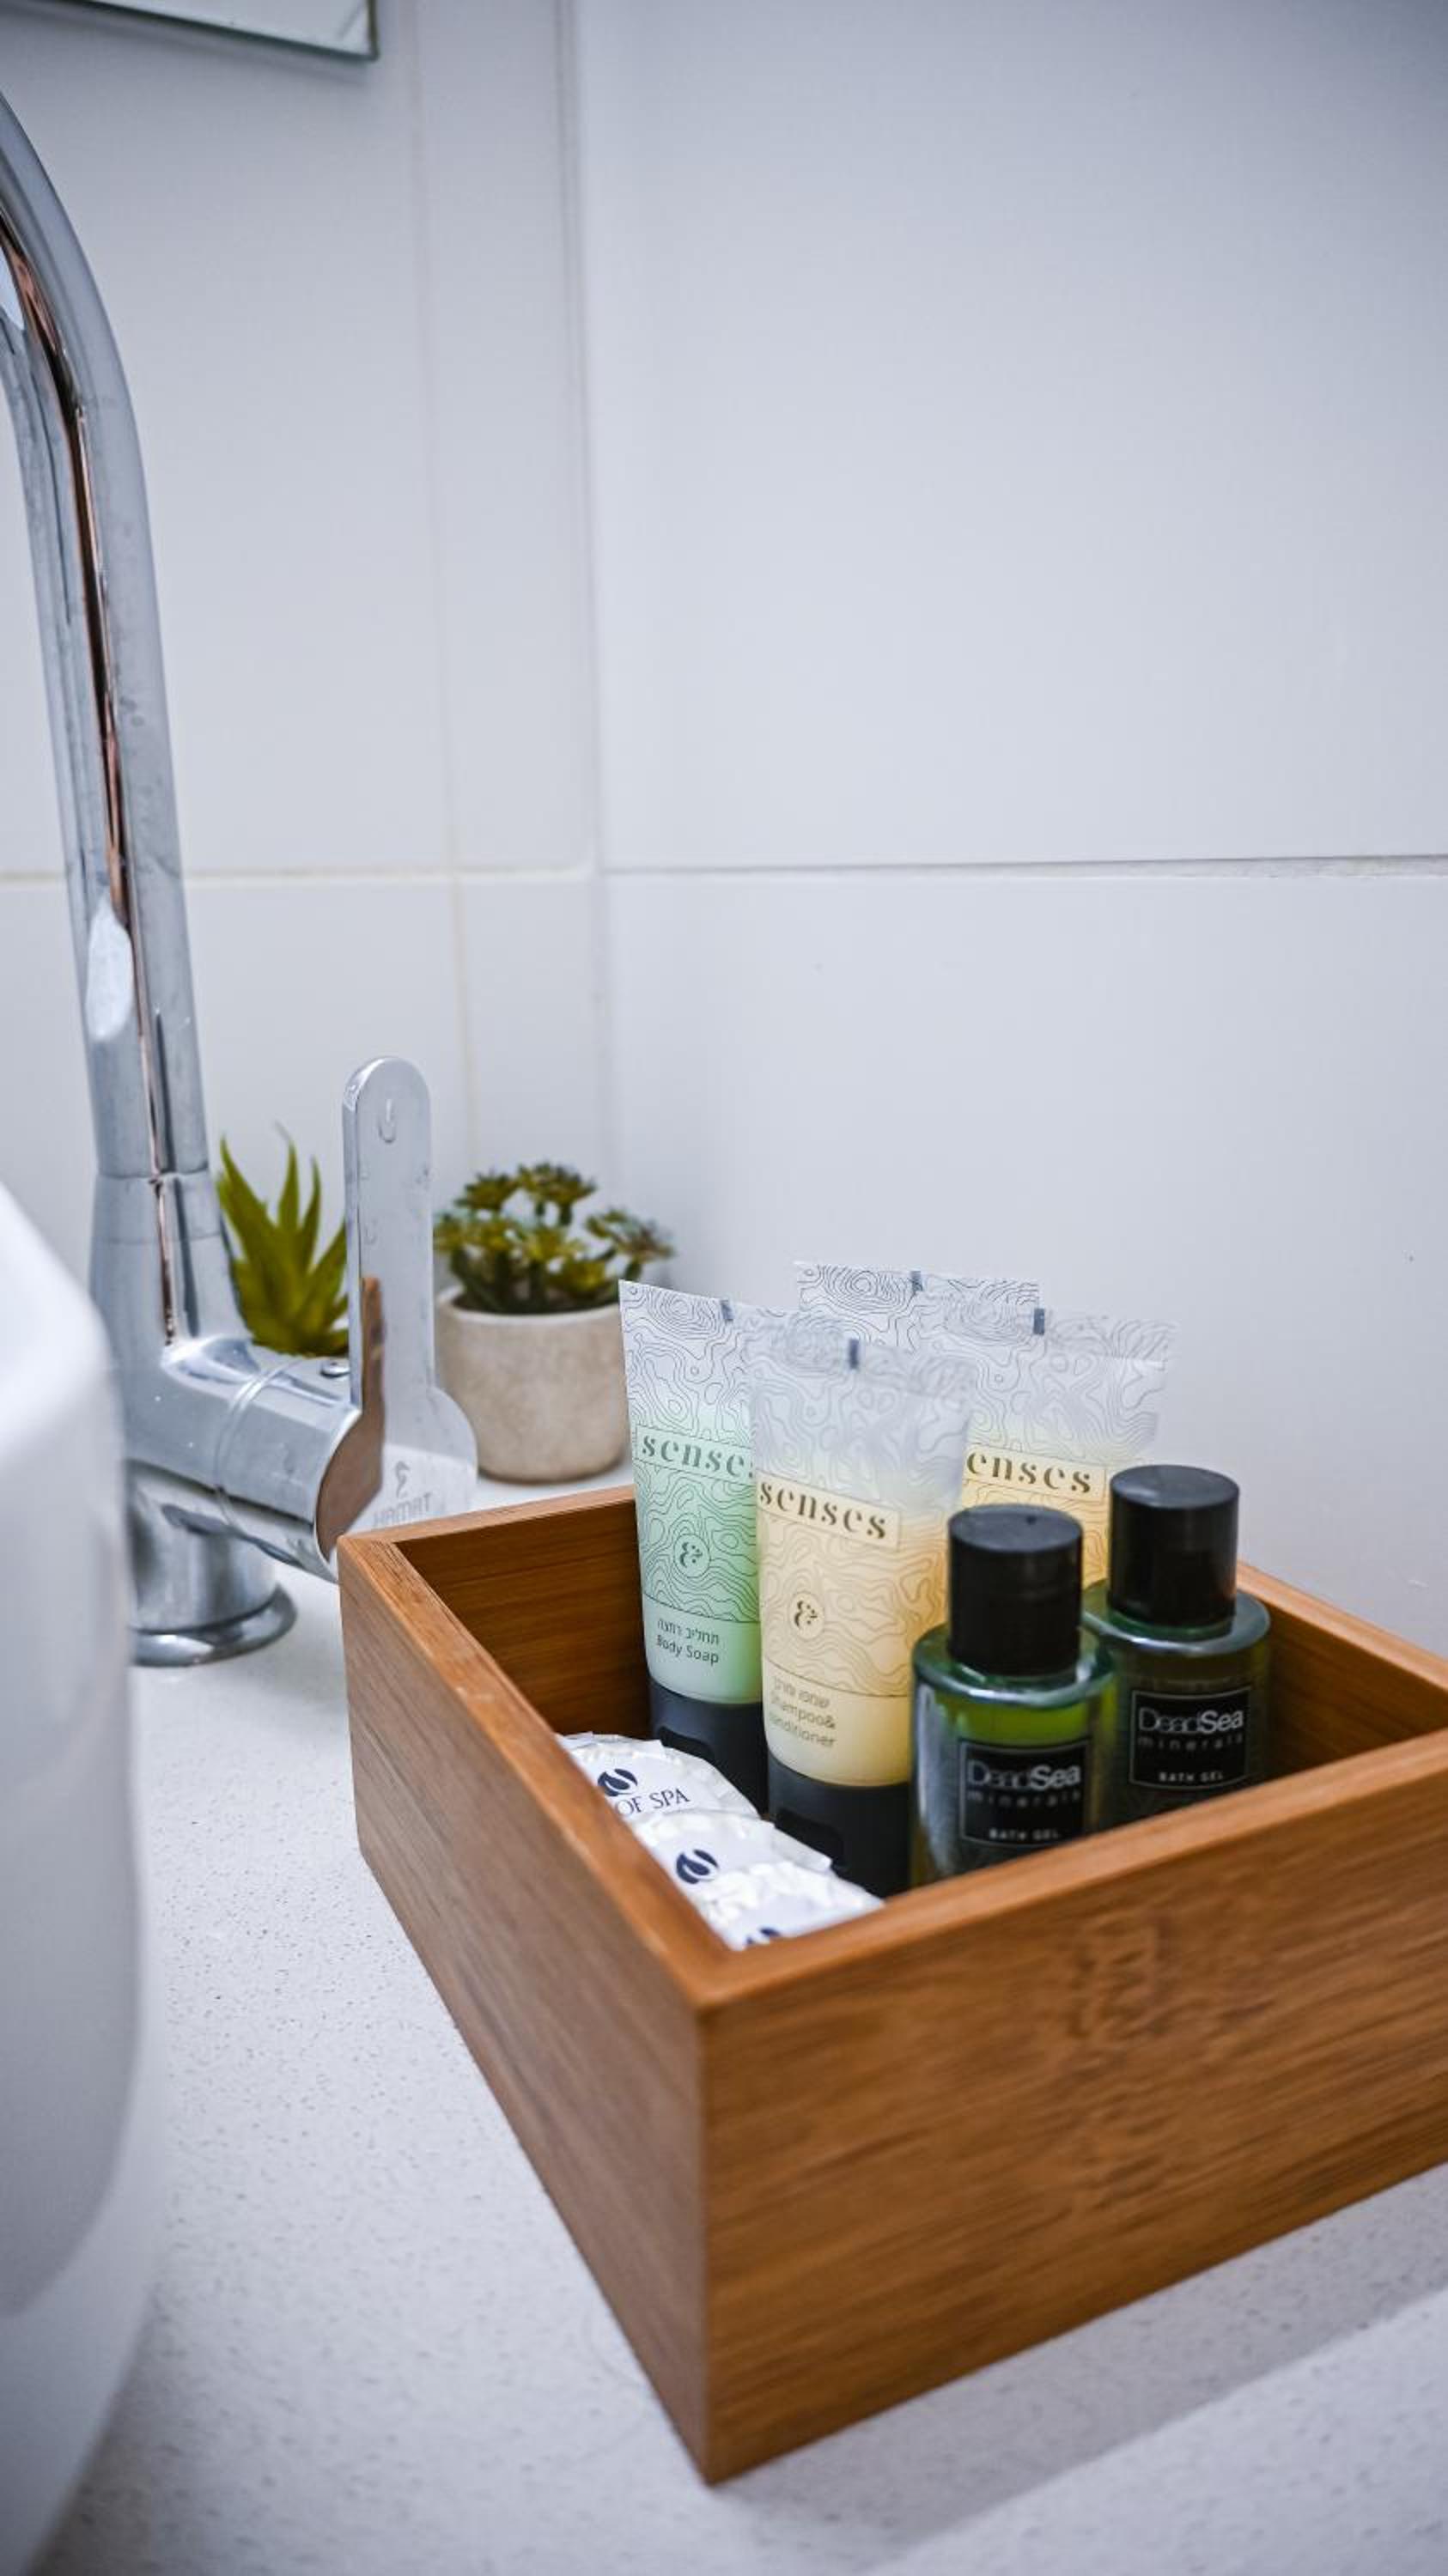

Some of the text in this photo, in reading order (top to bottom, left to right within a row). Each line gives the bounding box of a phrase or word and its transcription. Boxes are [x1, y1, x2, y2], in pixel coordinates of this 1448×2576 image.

[966, 1452, 1091, 1493] enses
[760, 1483, 885, 1539] senses
[656, 1634, 719, 1666] Body Soap
[1138, 1707, 1244, 1735] DeadSea
[1159, 1771, 1224, 1783] BATH GEL
[614, 1789, 691, 1817] OF SPA
[989, 1828, 1060, 1841] BATH GEL
